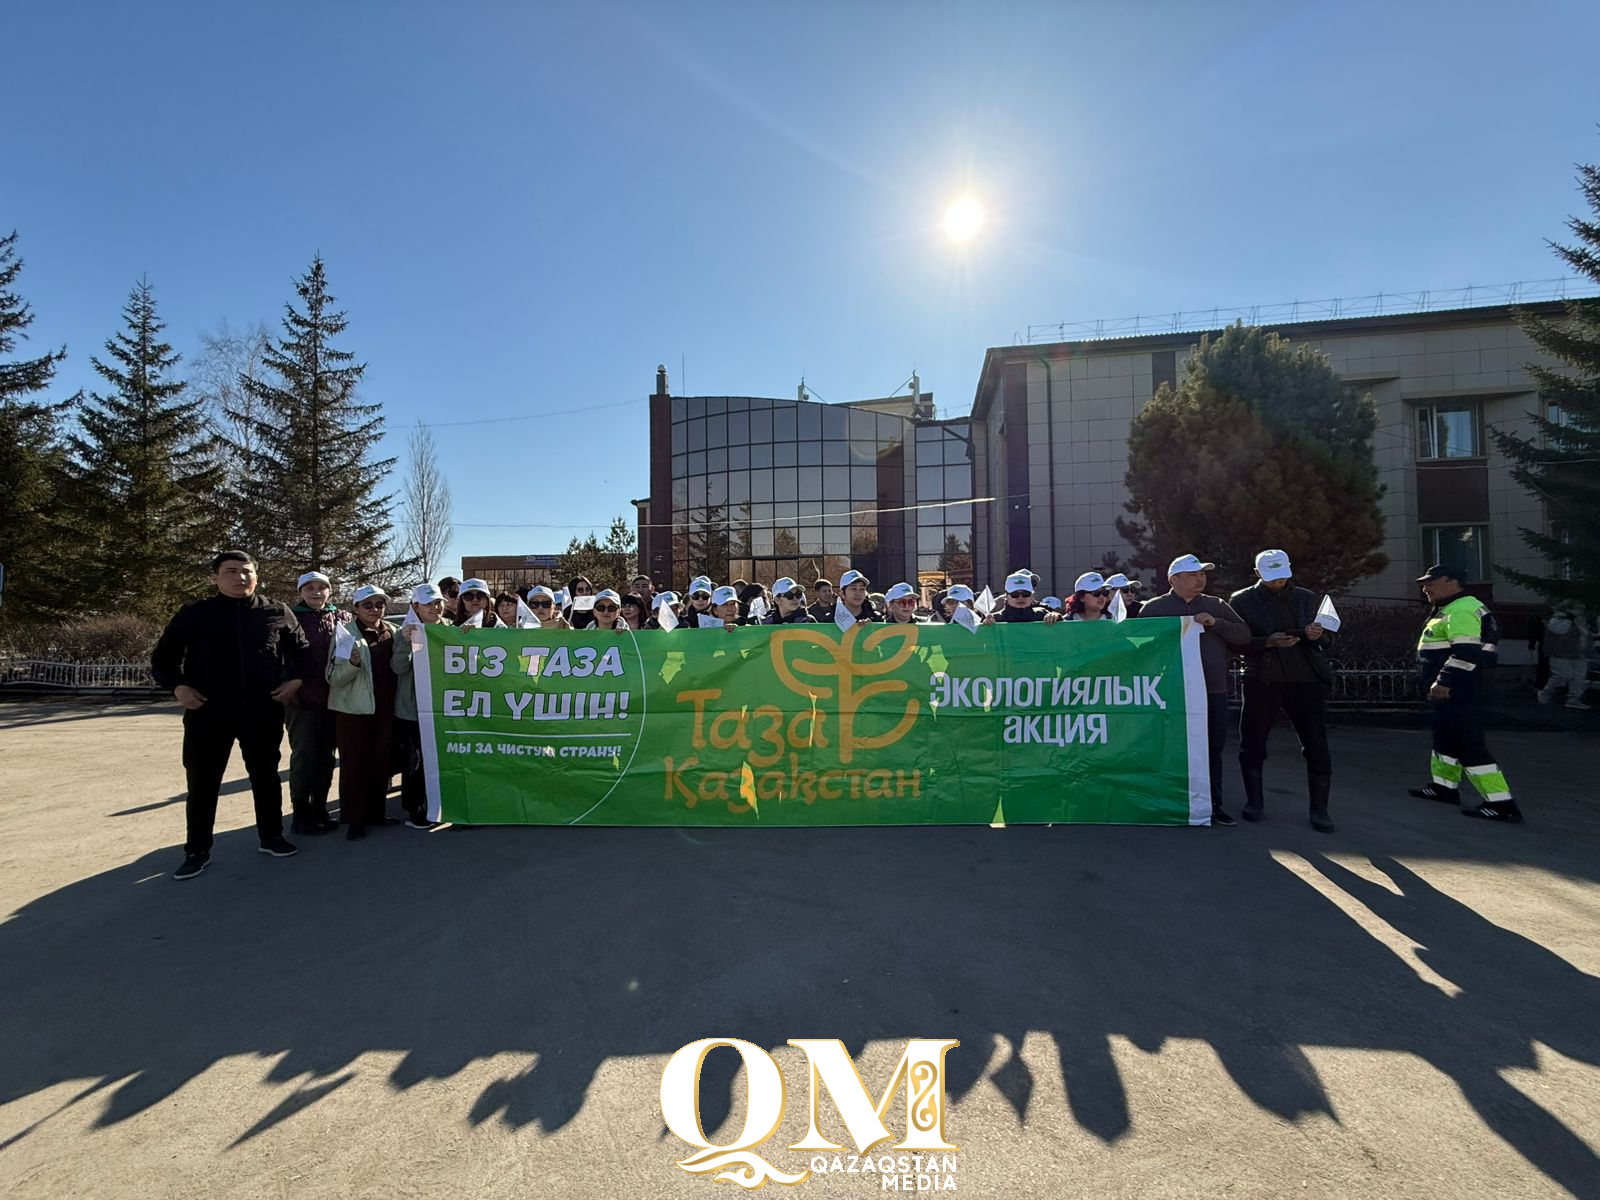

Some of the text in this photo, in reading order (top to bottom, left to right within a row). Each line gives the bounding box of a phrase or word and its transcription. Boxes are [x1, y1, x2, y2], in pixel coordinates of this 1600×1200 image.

[443, 645, 625, 678] БІЗ ТАЗА
[443, 690, 631, 722] ЕЛ ҮШІН!
[929, 671, 1167, 710] Экологиялық
[676, 688, 829, 768] Таза
[1003, 713, 1108, 748] акция
[446, 742, 622, 758] МЫ ЗА ЧИСТУЮ СТРАНУ!
